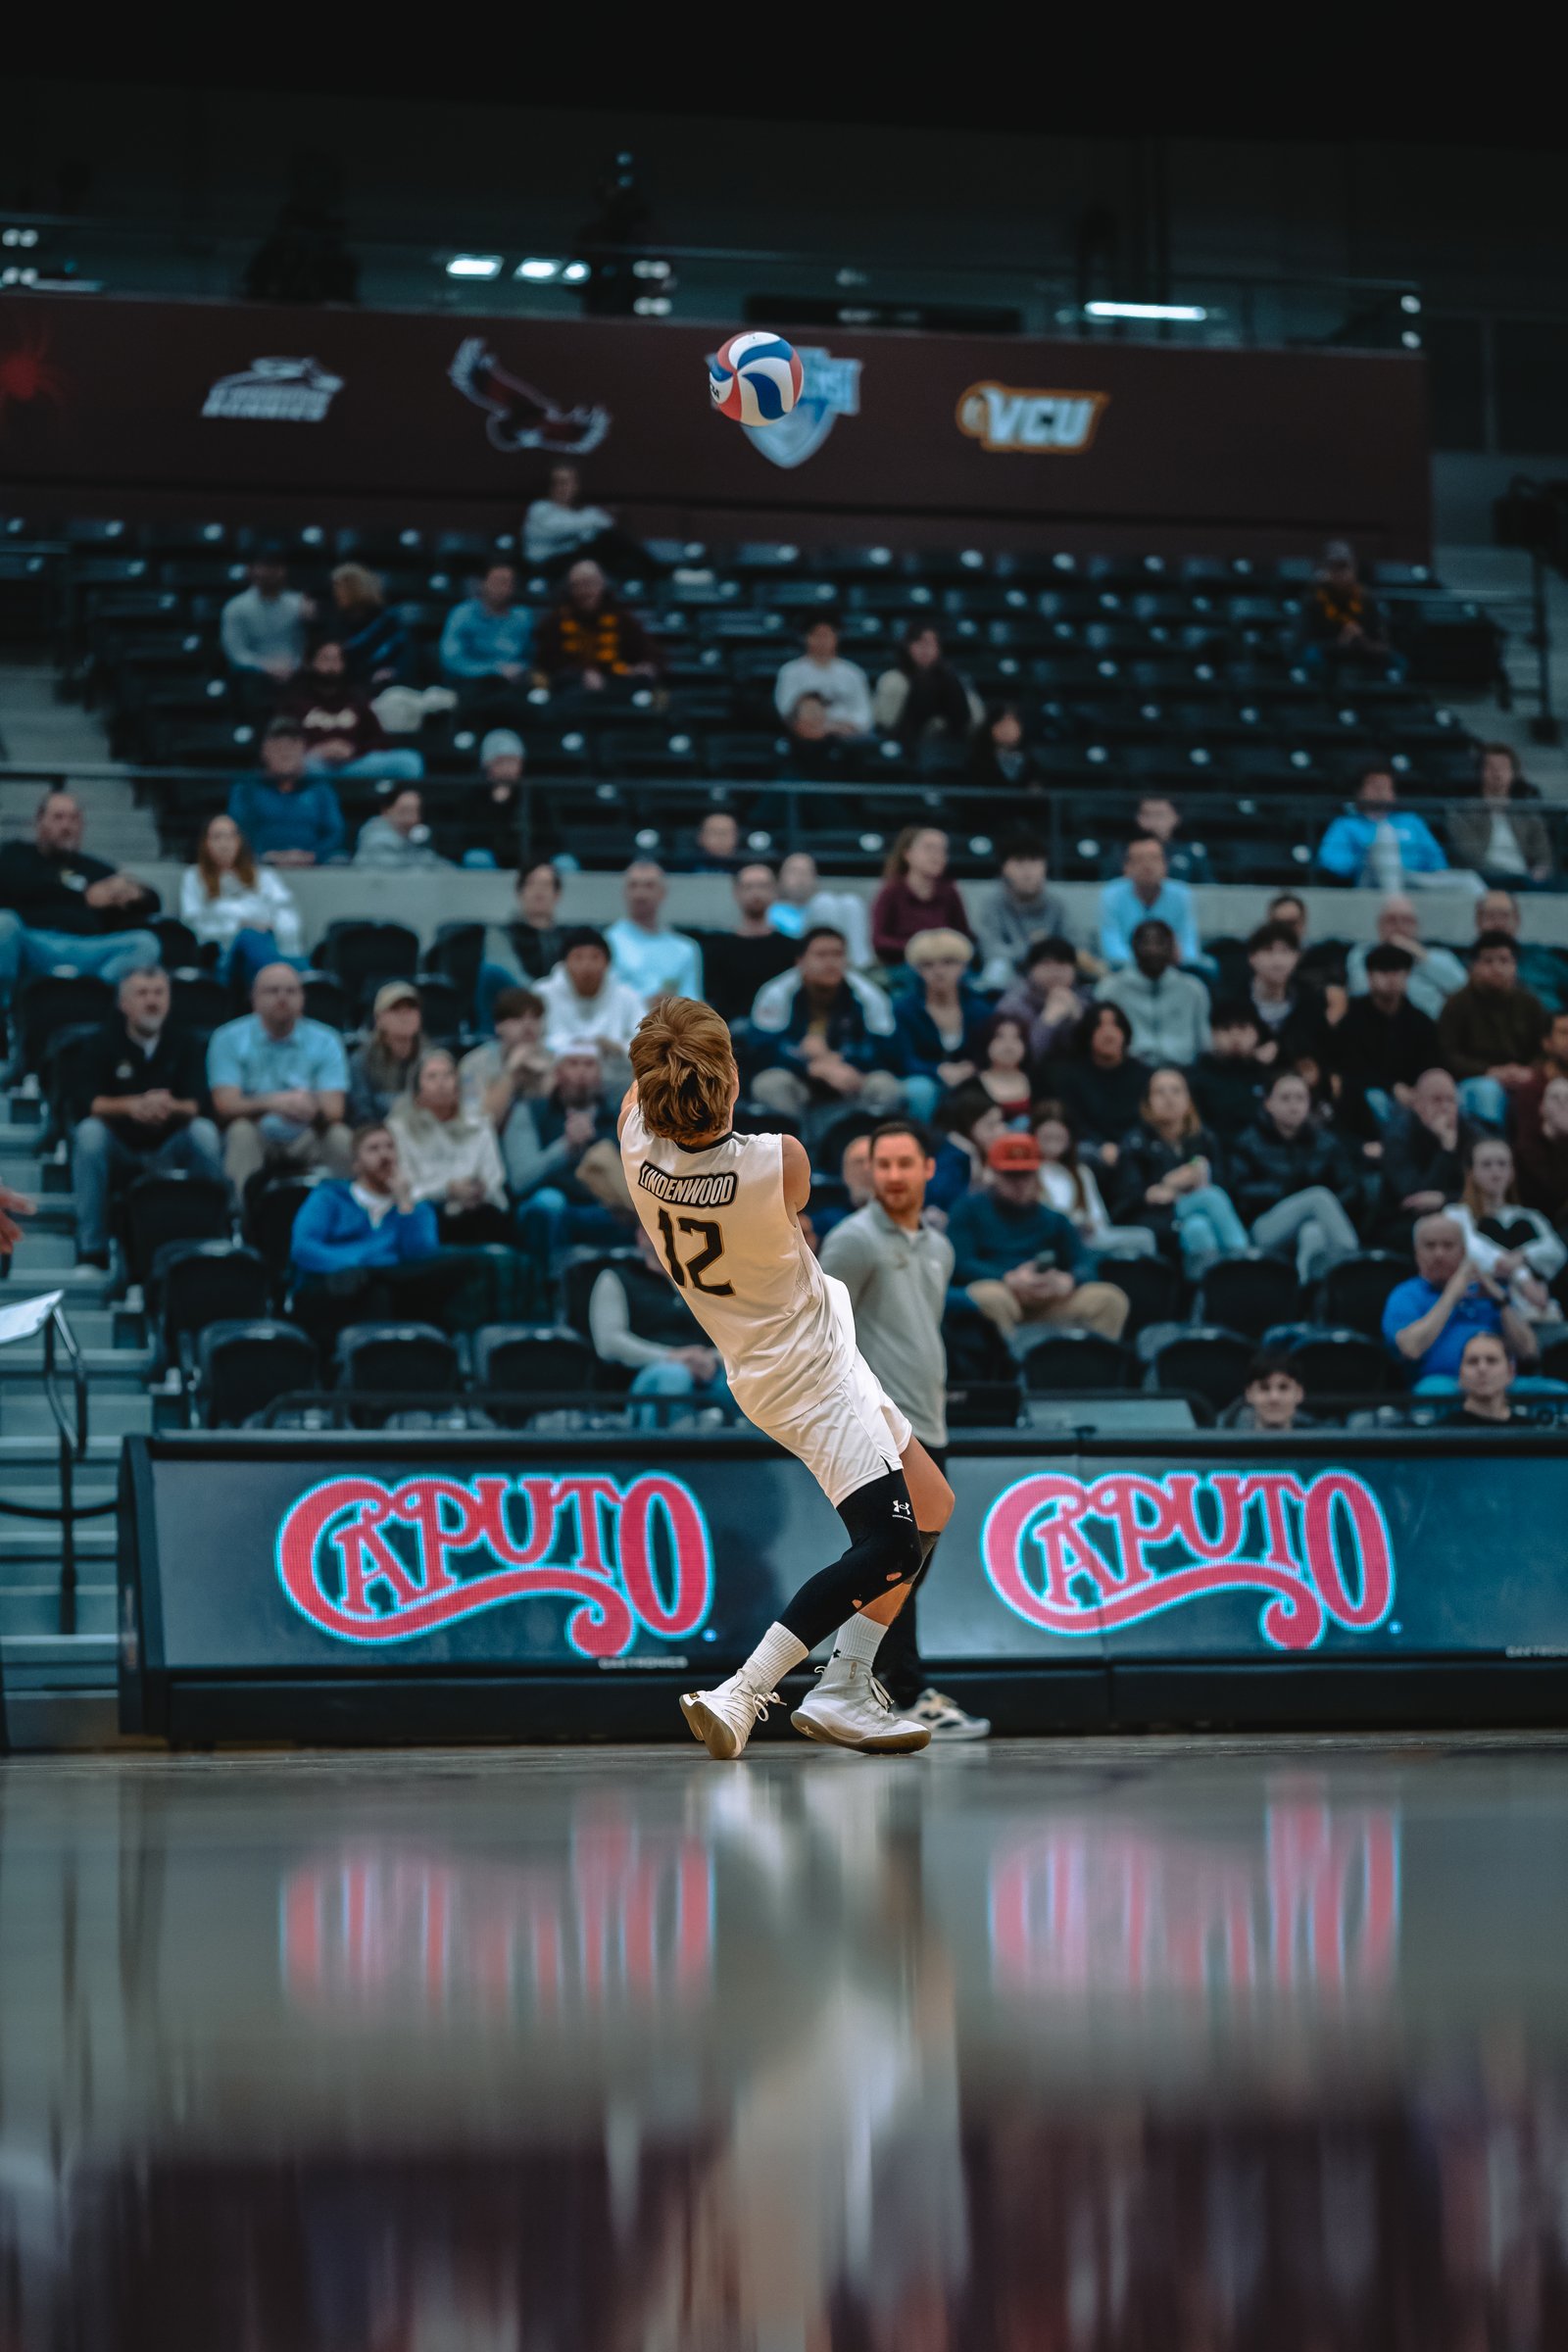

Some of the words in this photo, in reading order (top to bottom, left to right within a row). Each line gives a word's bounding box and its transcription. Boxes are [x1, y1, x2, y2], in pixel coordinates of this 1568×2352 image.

[978, 385, 1096, 448] VCU
[638, 1162, 735, 1206] LINDENWOOD
[658, 1205, 735, 1298] 12
[276, 1471, 713, 1658] CAPUTO
[982, 1467, 1396, 1650] CAPUTO
